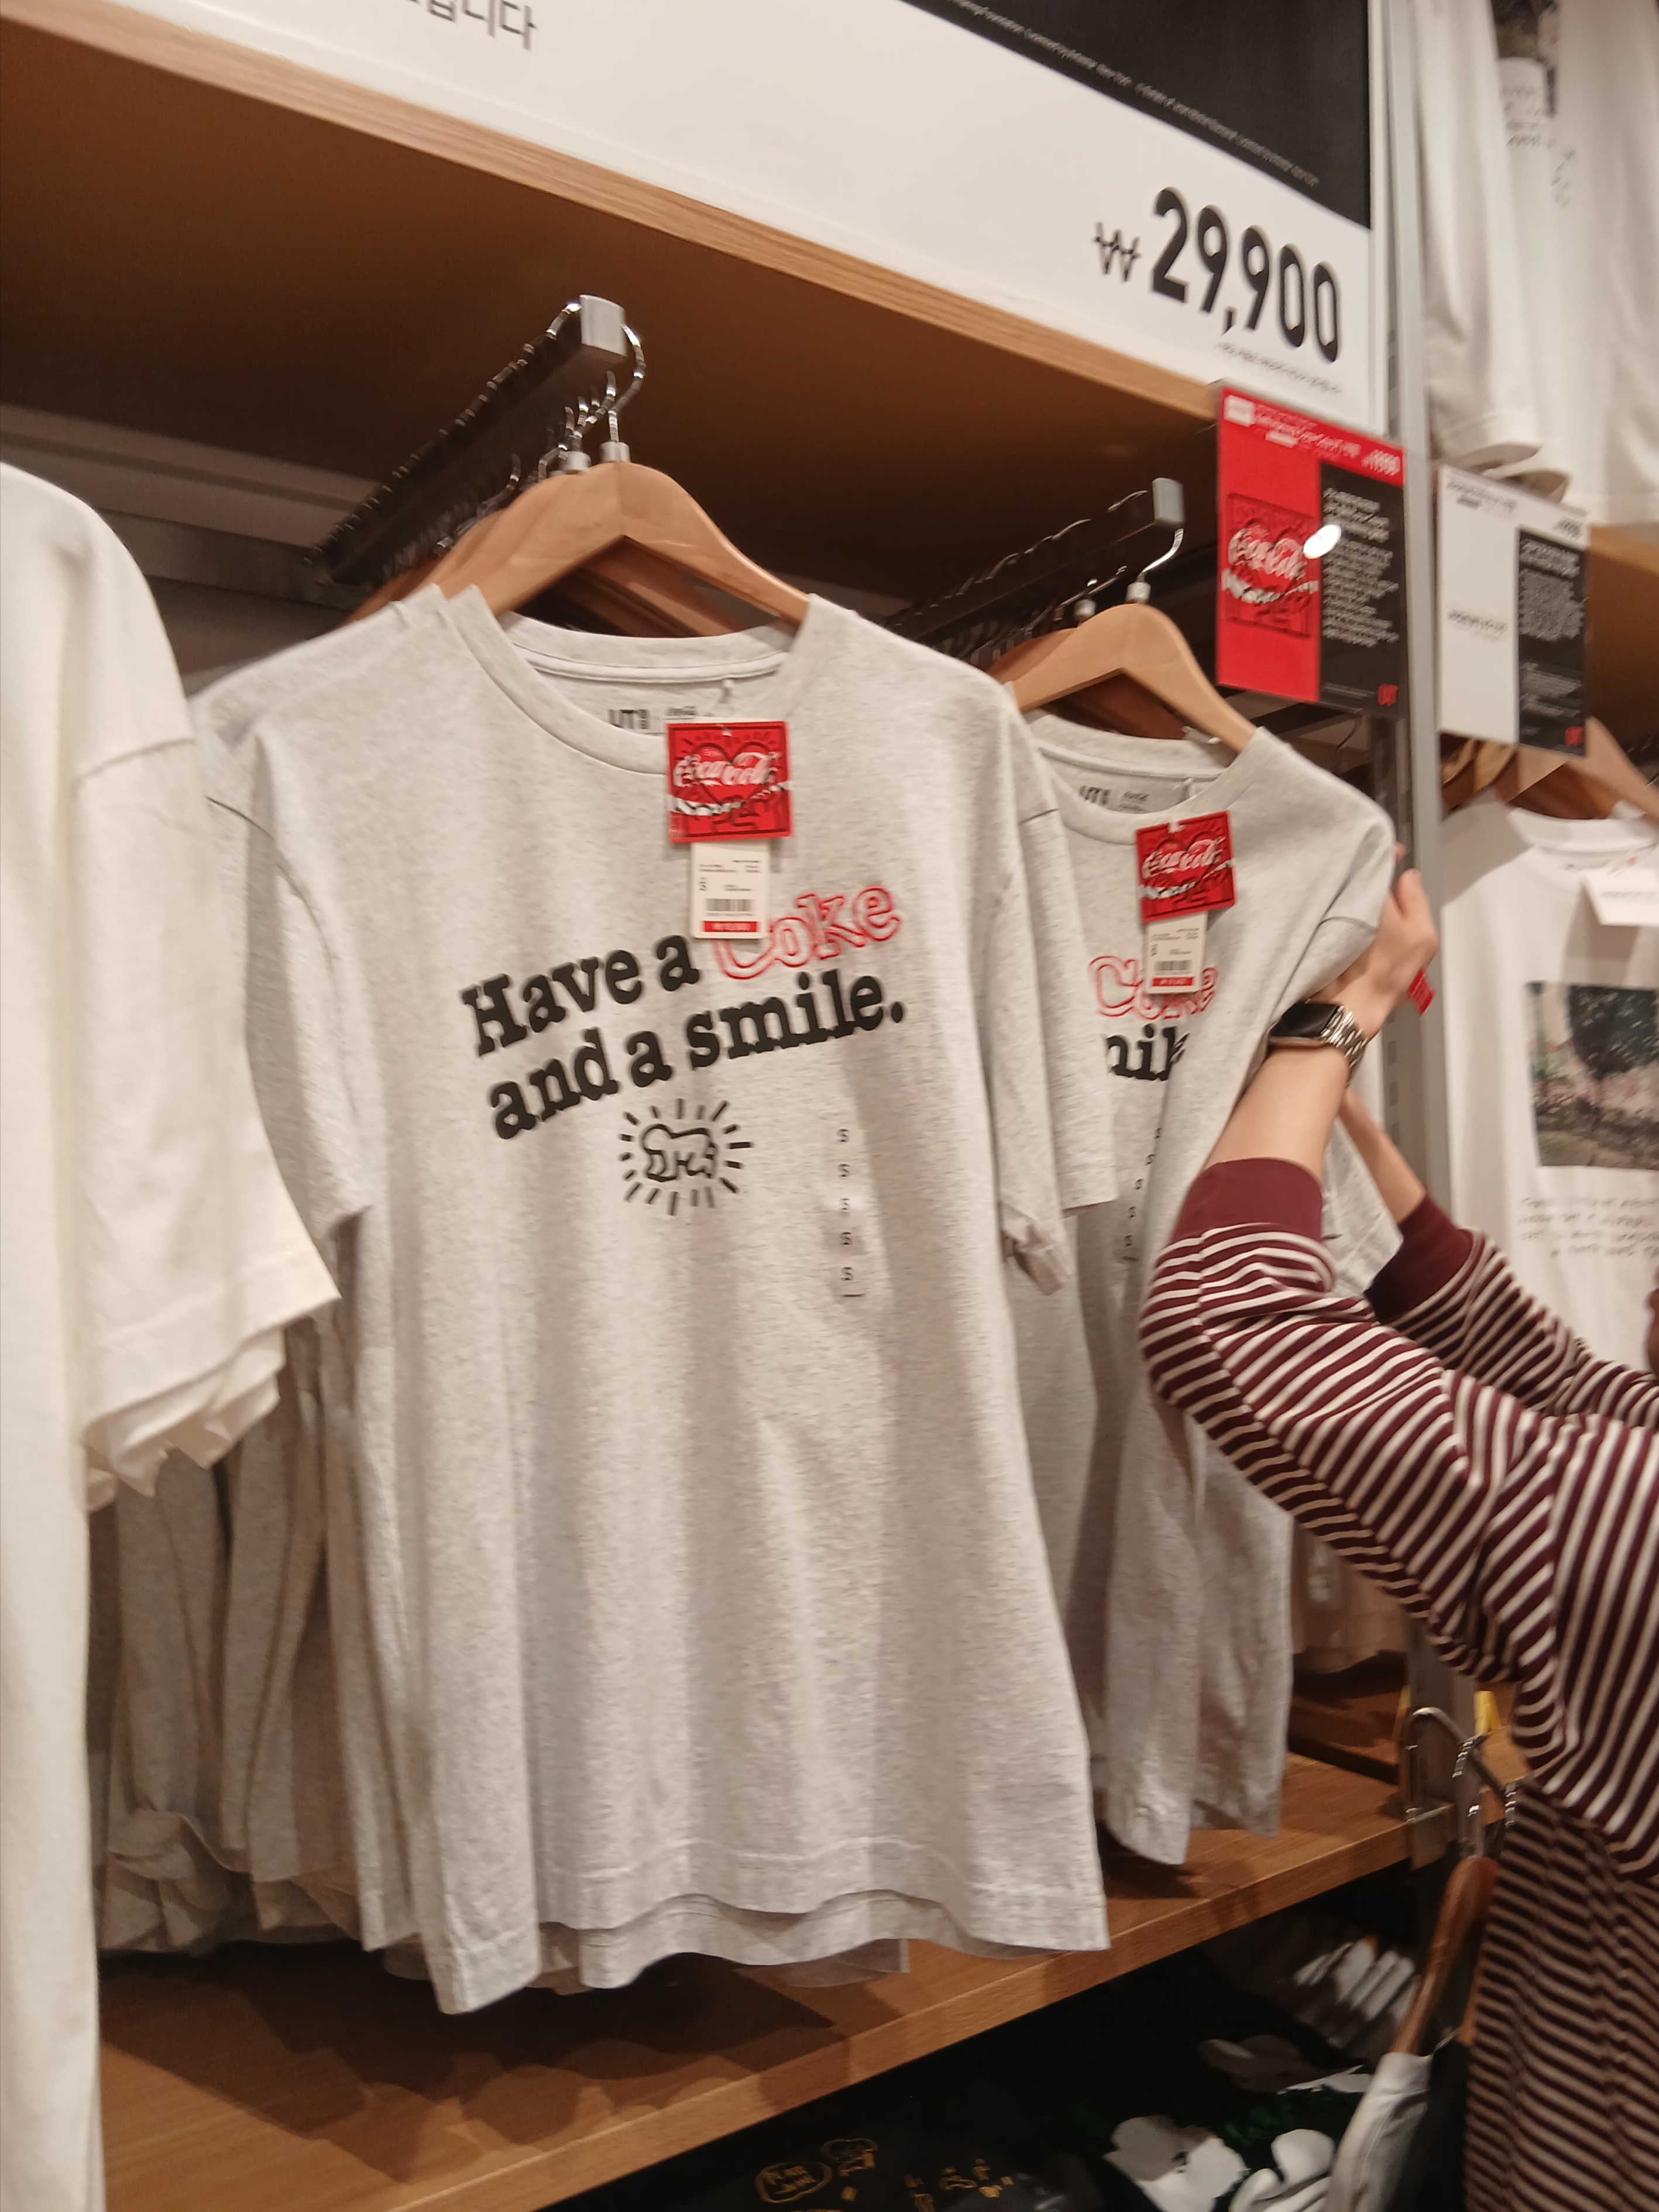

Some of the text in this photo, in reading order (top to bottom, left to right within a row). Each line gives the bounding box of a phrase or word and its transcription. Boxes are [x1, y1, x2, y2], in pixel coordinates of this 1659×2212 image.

[462, 949, 644, 1057] Have
[656, 935, 701, 992] a
[490, 968, 907, 1139] and a smile.
